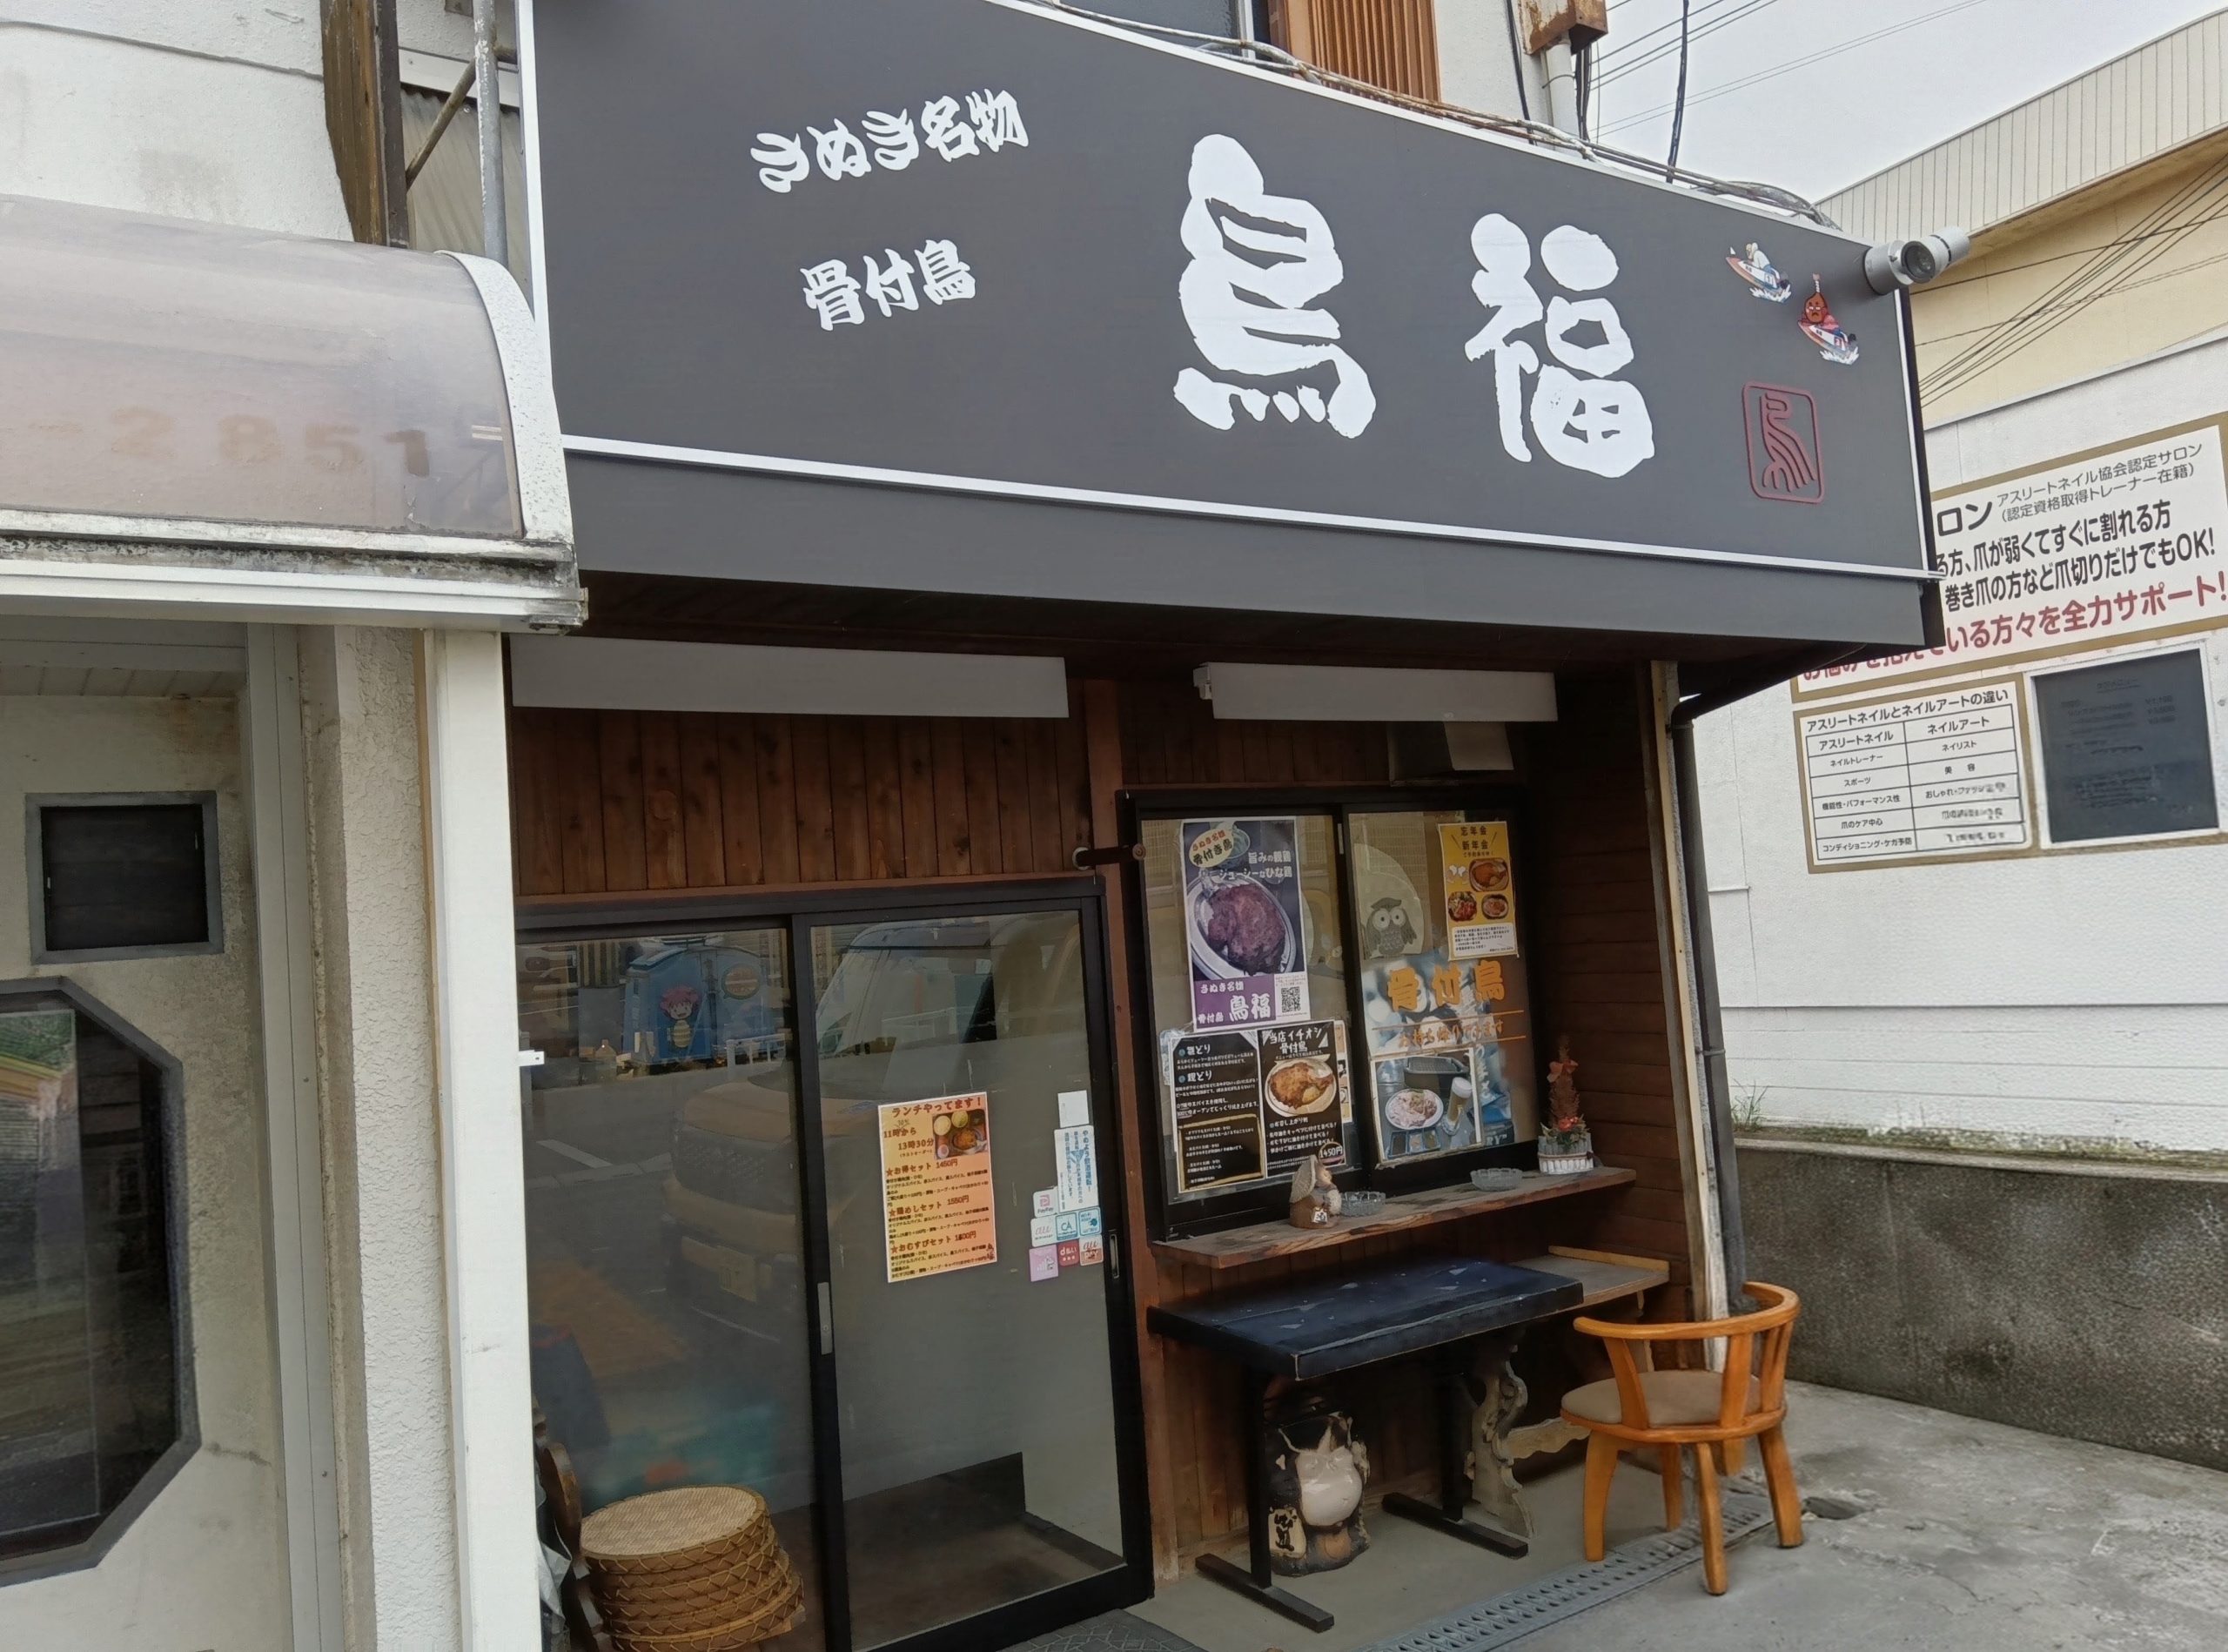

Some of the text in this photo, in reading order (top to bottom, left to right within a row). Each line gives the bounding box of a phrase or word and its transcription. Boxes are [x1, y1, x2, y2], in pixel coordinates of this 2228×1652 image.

[750, 89, 1029, 192] さぬき名物
[800, 239, 976, 331] 骨付鳥
[1996, 444, 2202, 507] アスリートネイル協会認定サロン
[2002, 462, 2194, 522] (認定資格取得トレーナー在籍)
[1936, 501, 1992, 536] ロン
[1936, 500, 2171, 577] る方、爪が弱くてすぐに割れる方
[1945, 527, 2215, 612] 巻き爪の方など爪切りだけでもOK!
[1808, 689, 2009, 732] アスリートネイルとネイルアートの違い
[1928, 716, 1990, 735] ネイルアート
[1819, 732, 1894, 751] アスリートネイル
[1942, 741, 1976, 752] ネイリスト
[1829, 755, 1883, 767] ネイルトレーナー
[1844, 776, 1871, 787] スポーツ
[1822, 794, 1901, 811] 機能性・パフォーマンス性
[1841, 818, 1883, 829] 爪のケア中心
[1823, 837, 1912, 853] コンディショニング・ケガ予防
[1387, 959, 1505, 1012] 骨付鳥
[1270, 1027, 1323, 1044] 当店イチオシ
